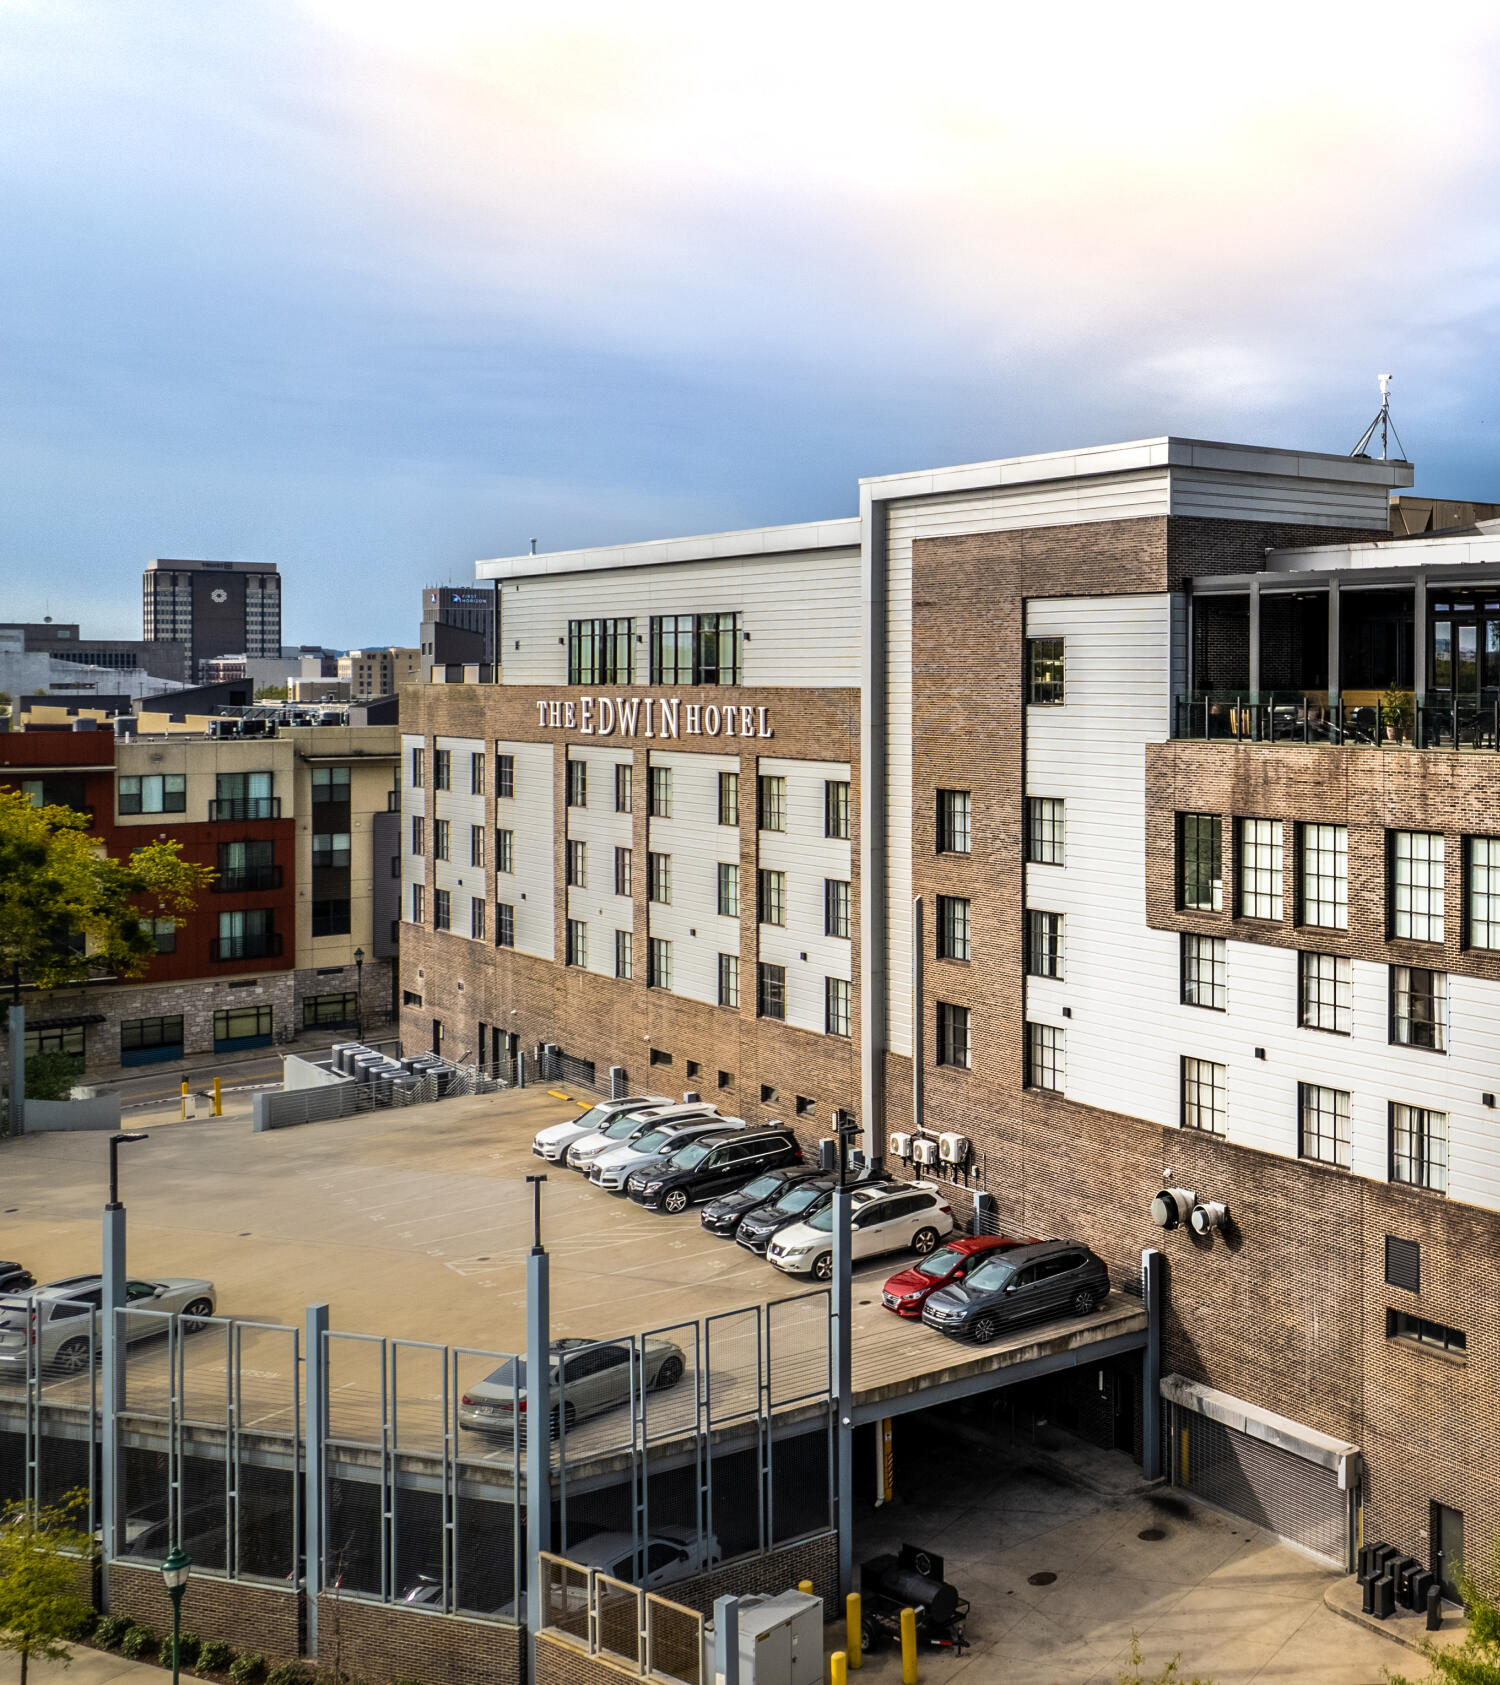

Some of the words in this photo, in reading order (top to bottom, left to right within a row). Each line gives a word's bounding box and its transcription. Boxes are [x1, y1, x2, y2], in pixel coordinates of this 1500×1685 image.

[536, 700, 576, 728] THE
[580, 697, 681, 738] EDWIN
[685, 705, 773, 738] HOTEL
